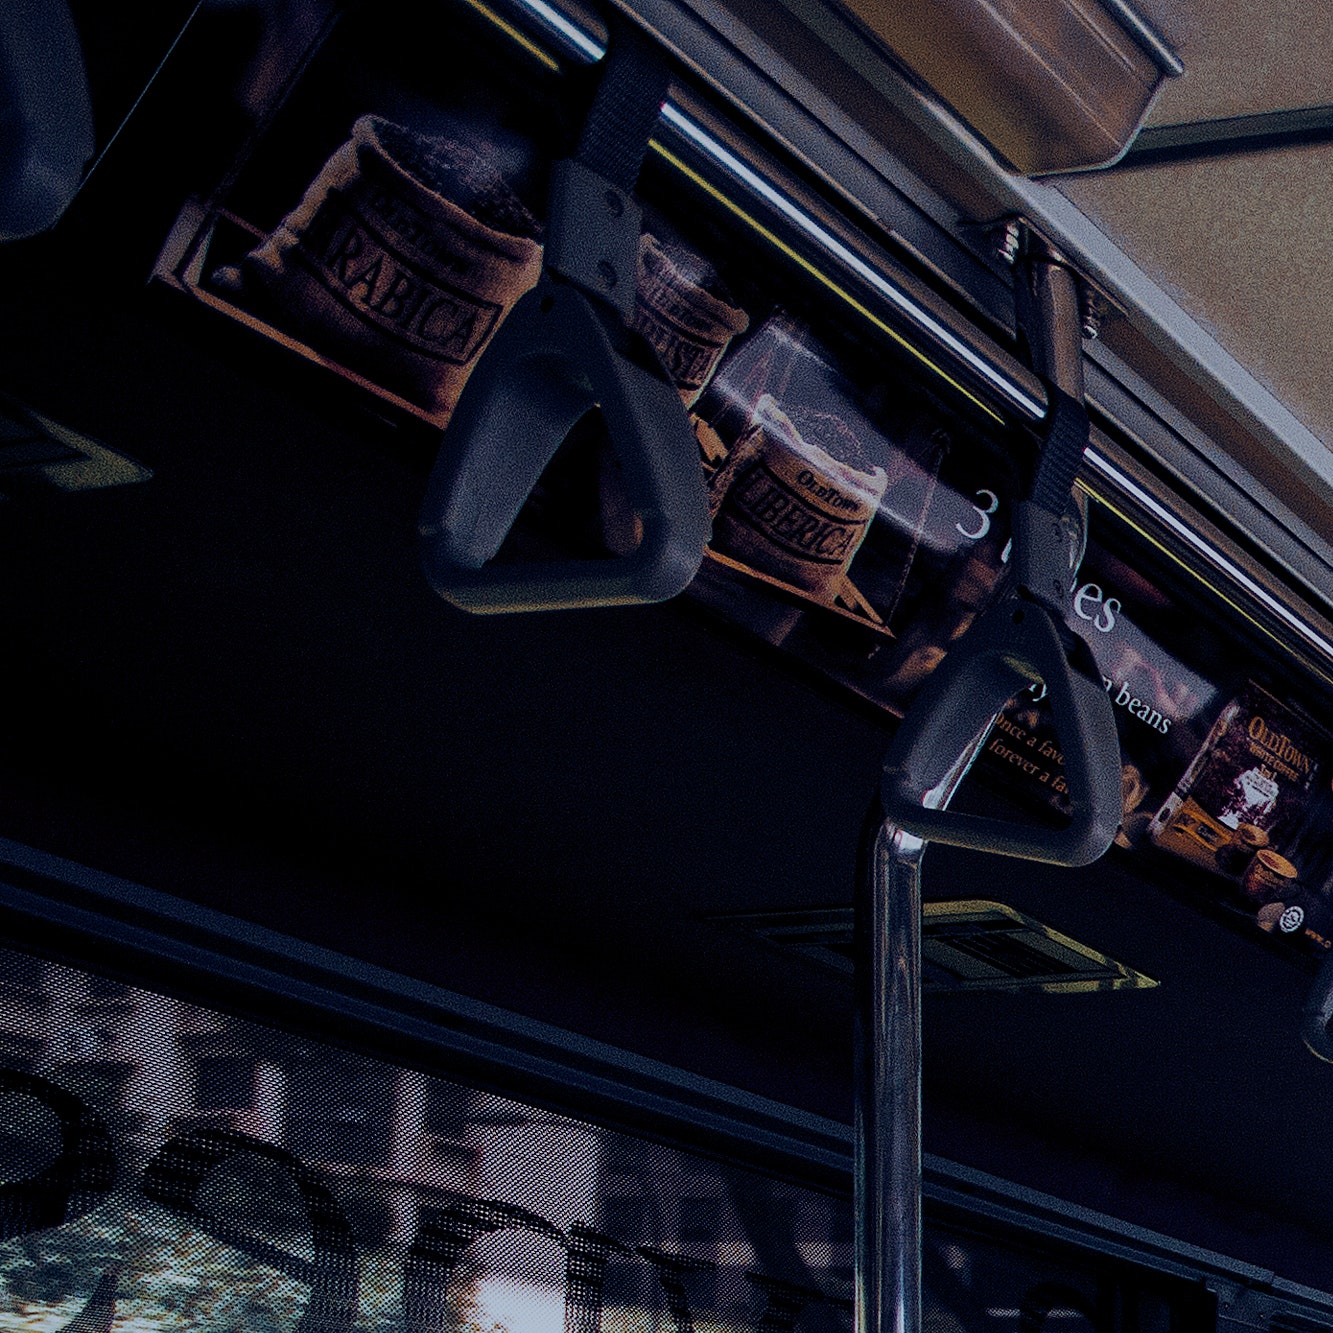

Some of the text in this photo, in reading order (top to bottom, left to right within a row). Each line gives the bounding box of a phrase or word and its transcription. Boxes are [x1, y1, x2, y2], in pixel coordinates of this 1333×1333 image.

[736, 466, 857, 557] LIBERICA
[955, 487, 999, 541] 3
[1114, 682, 1173, 736] beans
[987, 737, 1041, 776] forever
[1037, 772, 1051, 784] a
